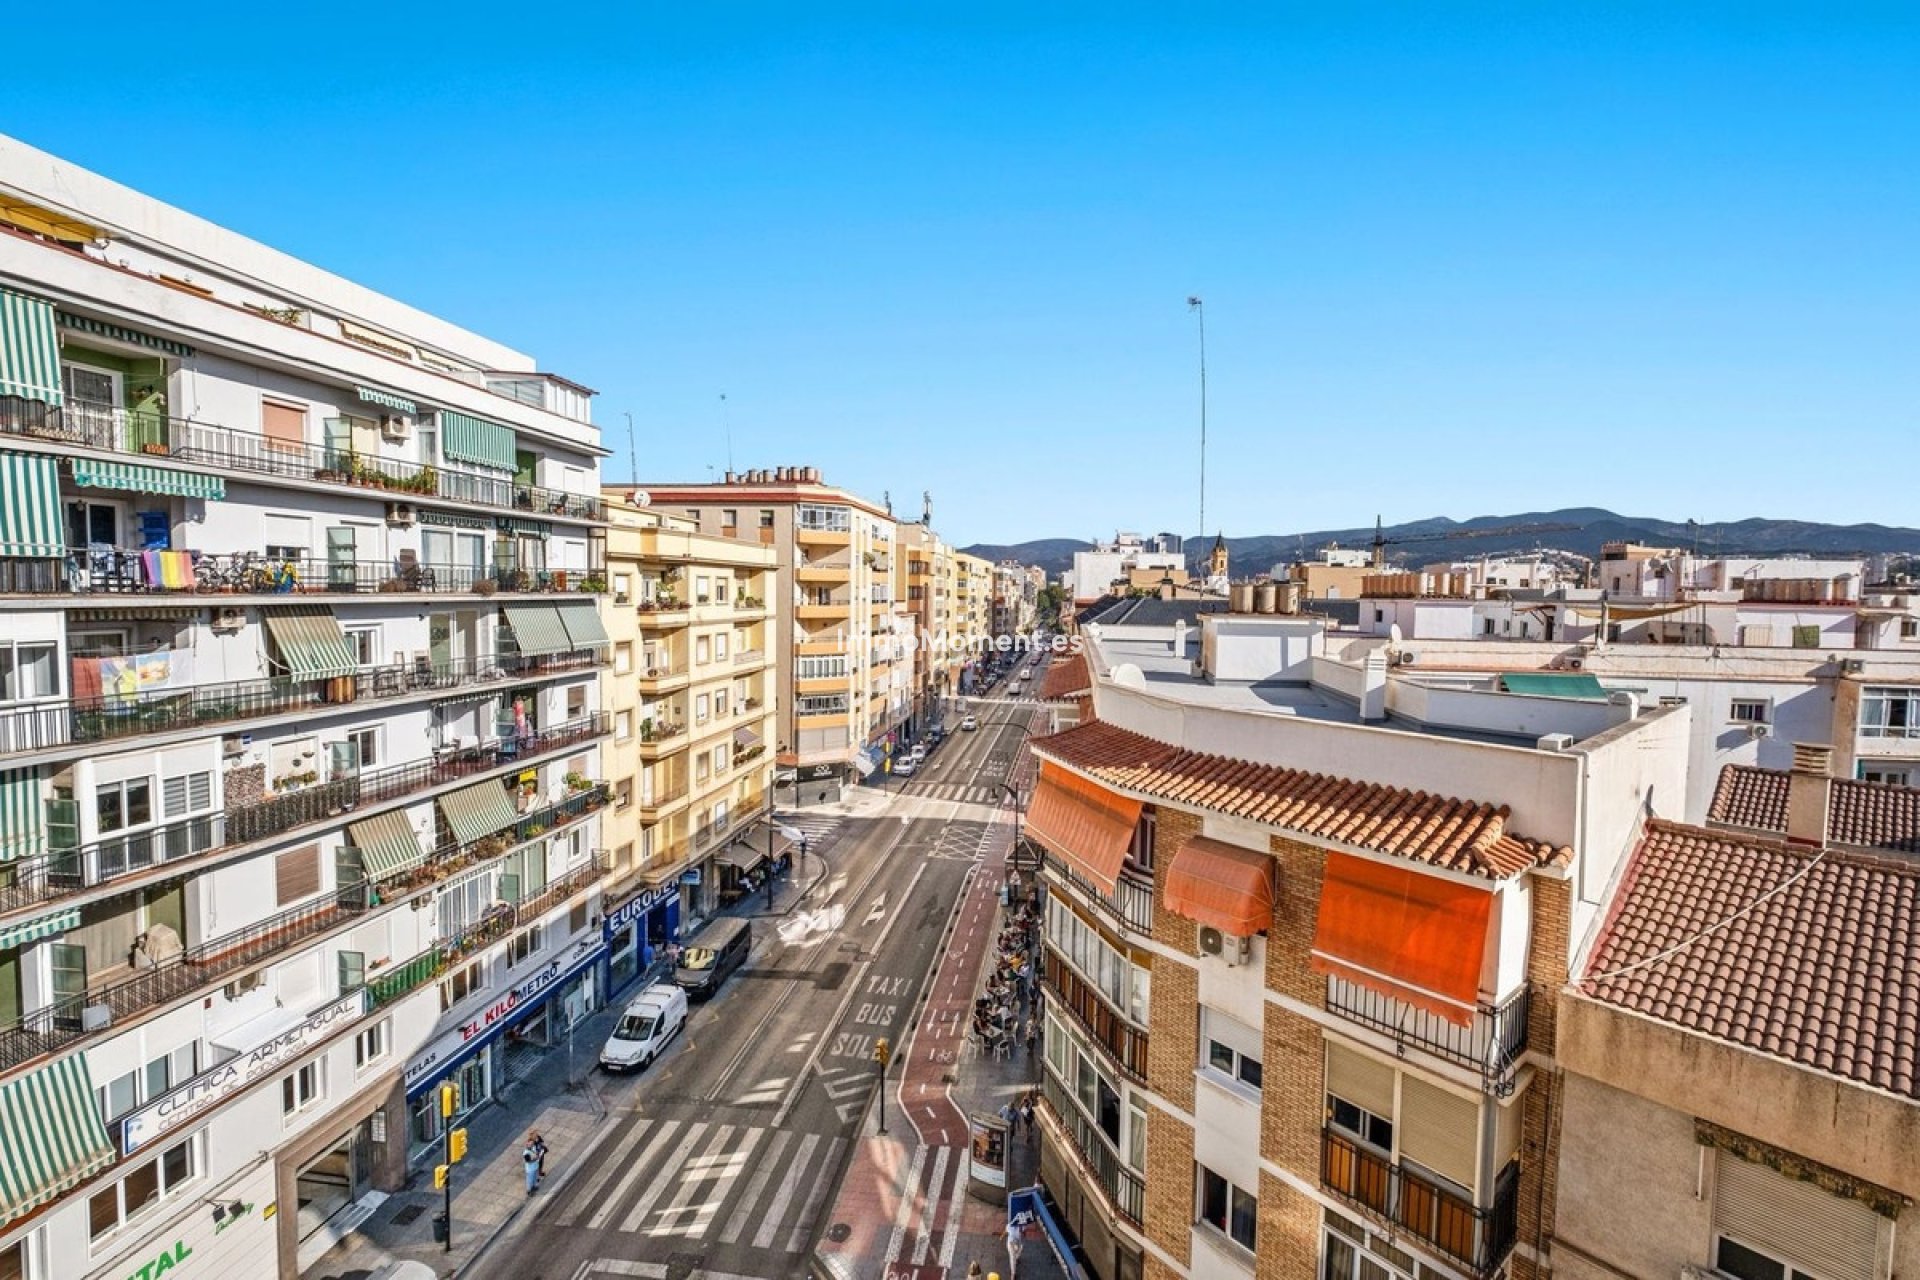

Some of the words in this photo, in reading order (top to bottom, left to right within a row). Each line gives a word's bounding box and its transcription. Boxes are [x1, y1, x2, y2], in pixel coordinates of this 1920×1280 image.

[866, 975, 913, 997] TAXI
[248, 1000, 355, 1068] ARMENGUAL
[854, 1002, 897, 1027] BUS
[405, 1052, 437, 1079] TELAS
[463, 1021, 480, 1041] EL
[158, 1093, 214, 1131] CENTRO
[221, 1078, 240, 1095] DE
[127, 1239, 193, 1280] TAL
